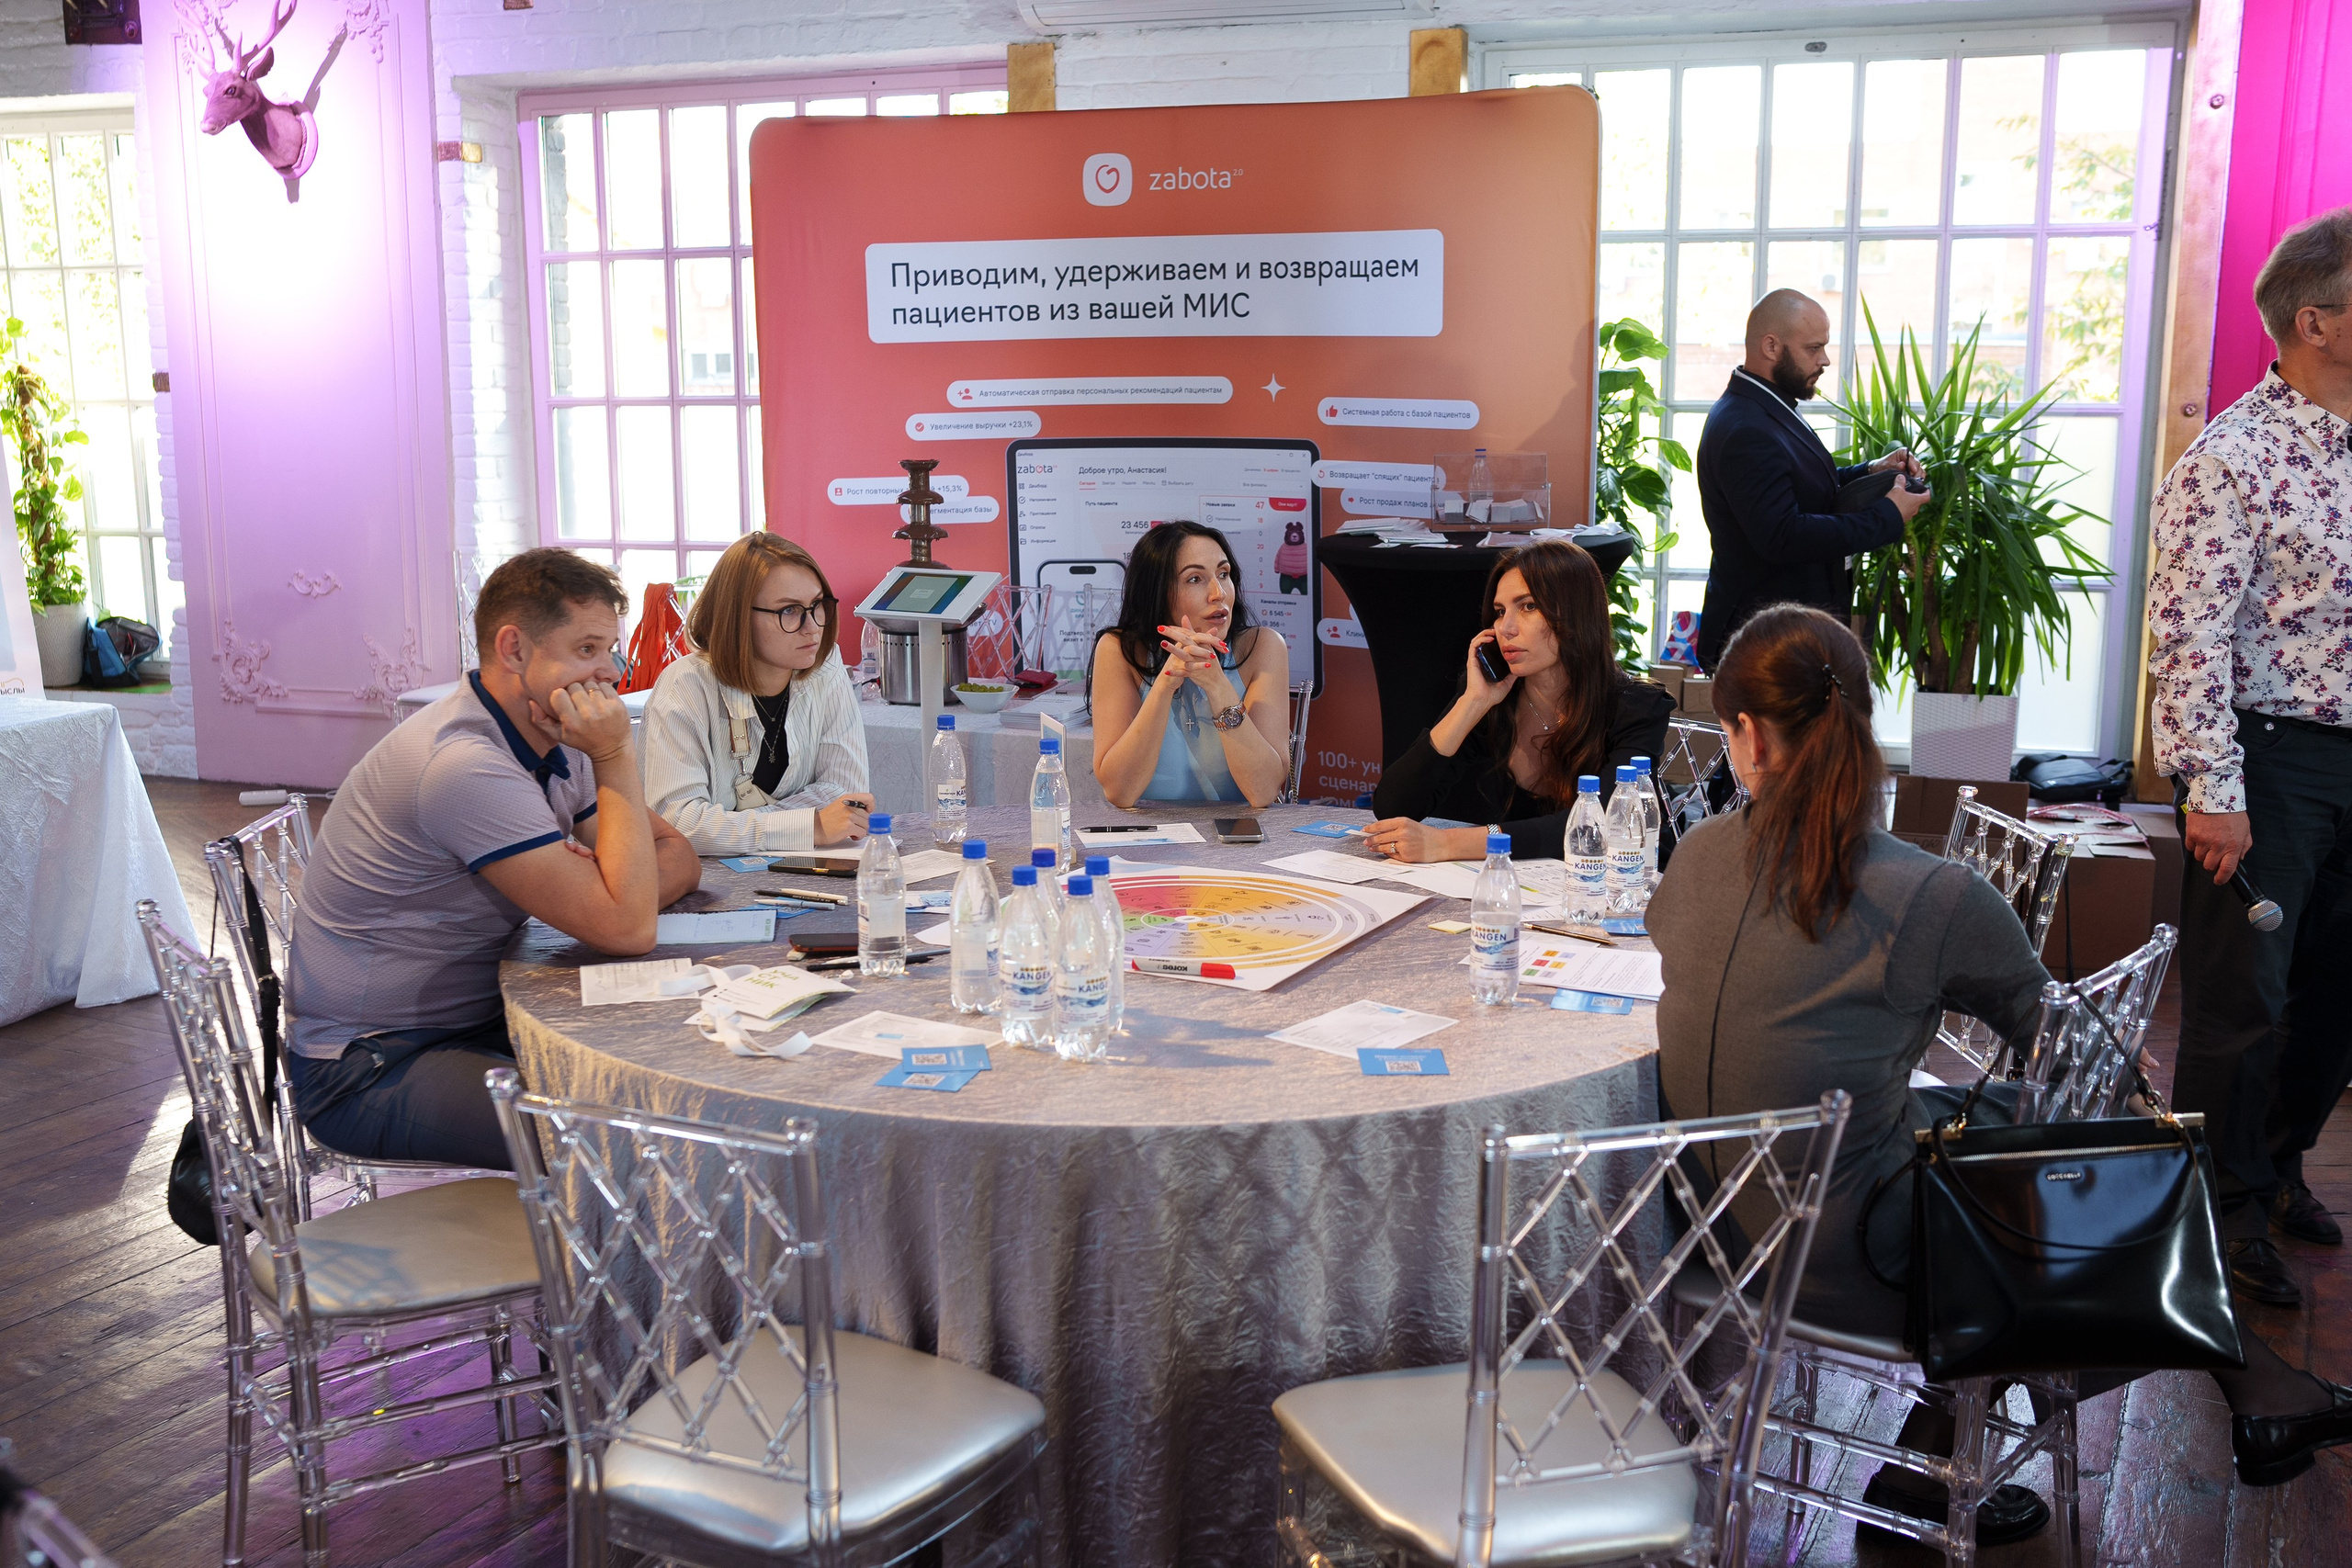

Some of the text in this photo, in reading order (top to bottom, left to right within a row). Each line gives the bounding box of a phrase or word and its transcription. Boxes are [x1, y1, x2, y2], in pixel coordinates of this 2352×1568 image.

[1148, 166, 1231, 191] zabota
[891, 258, 1419, 294] Приводим, удерживаем и возвращаем
[892, 292, 1250, 328] пациентов из вашей МИС
[978, 386, 1223, 398] Автоматическая отправка персональных рекомендаций пациентам
[1342, 407, 1380, 416] Системная
[1381, 409, 1405, 418] работа
[1412, 409, 1432, 418] базой
[1433, 411, 1471, 420] пациентов
[930, 420, 1034, 431] Увеличение выручки +23,1%
[1079, 467, 1168, 476] Доброе утро, Анастасия!
[1329, 470, 1370, 480] Возвращает
[846, 487, 864, 496] Рост
[865, 486, 904, 497] повторных
[937, 484, 963, 493] +15,3%
[1255, 501, 1265, 510] 47
[1359, 497, 1375, 505] Рост
[1376, 498, 1403, 508] продаж
[1404, 501, 1428, 509] планов
[930, 504, 993, 516] егментация базы
[1121, 520, 1149, 529] 23 456
[1345, 629, 1366, 638] Клини
[1317, 750, 1381, 776] 100+ ун
[1319, 775, 1378, 792] сценар
[1612, 853, 1645, 863] KANGEN
[757, 972, 781, 981] СТ
[772, 969, 800, 981] УЧА
[744, 976, 780, 989] НИК
